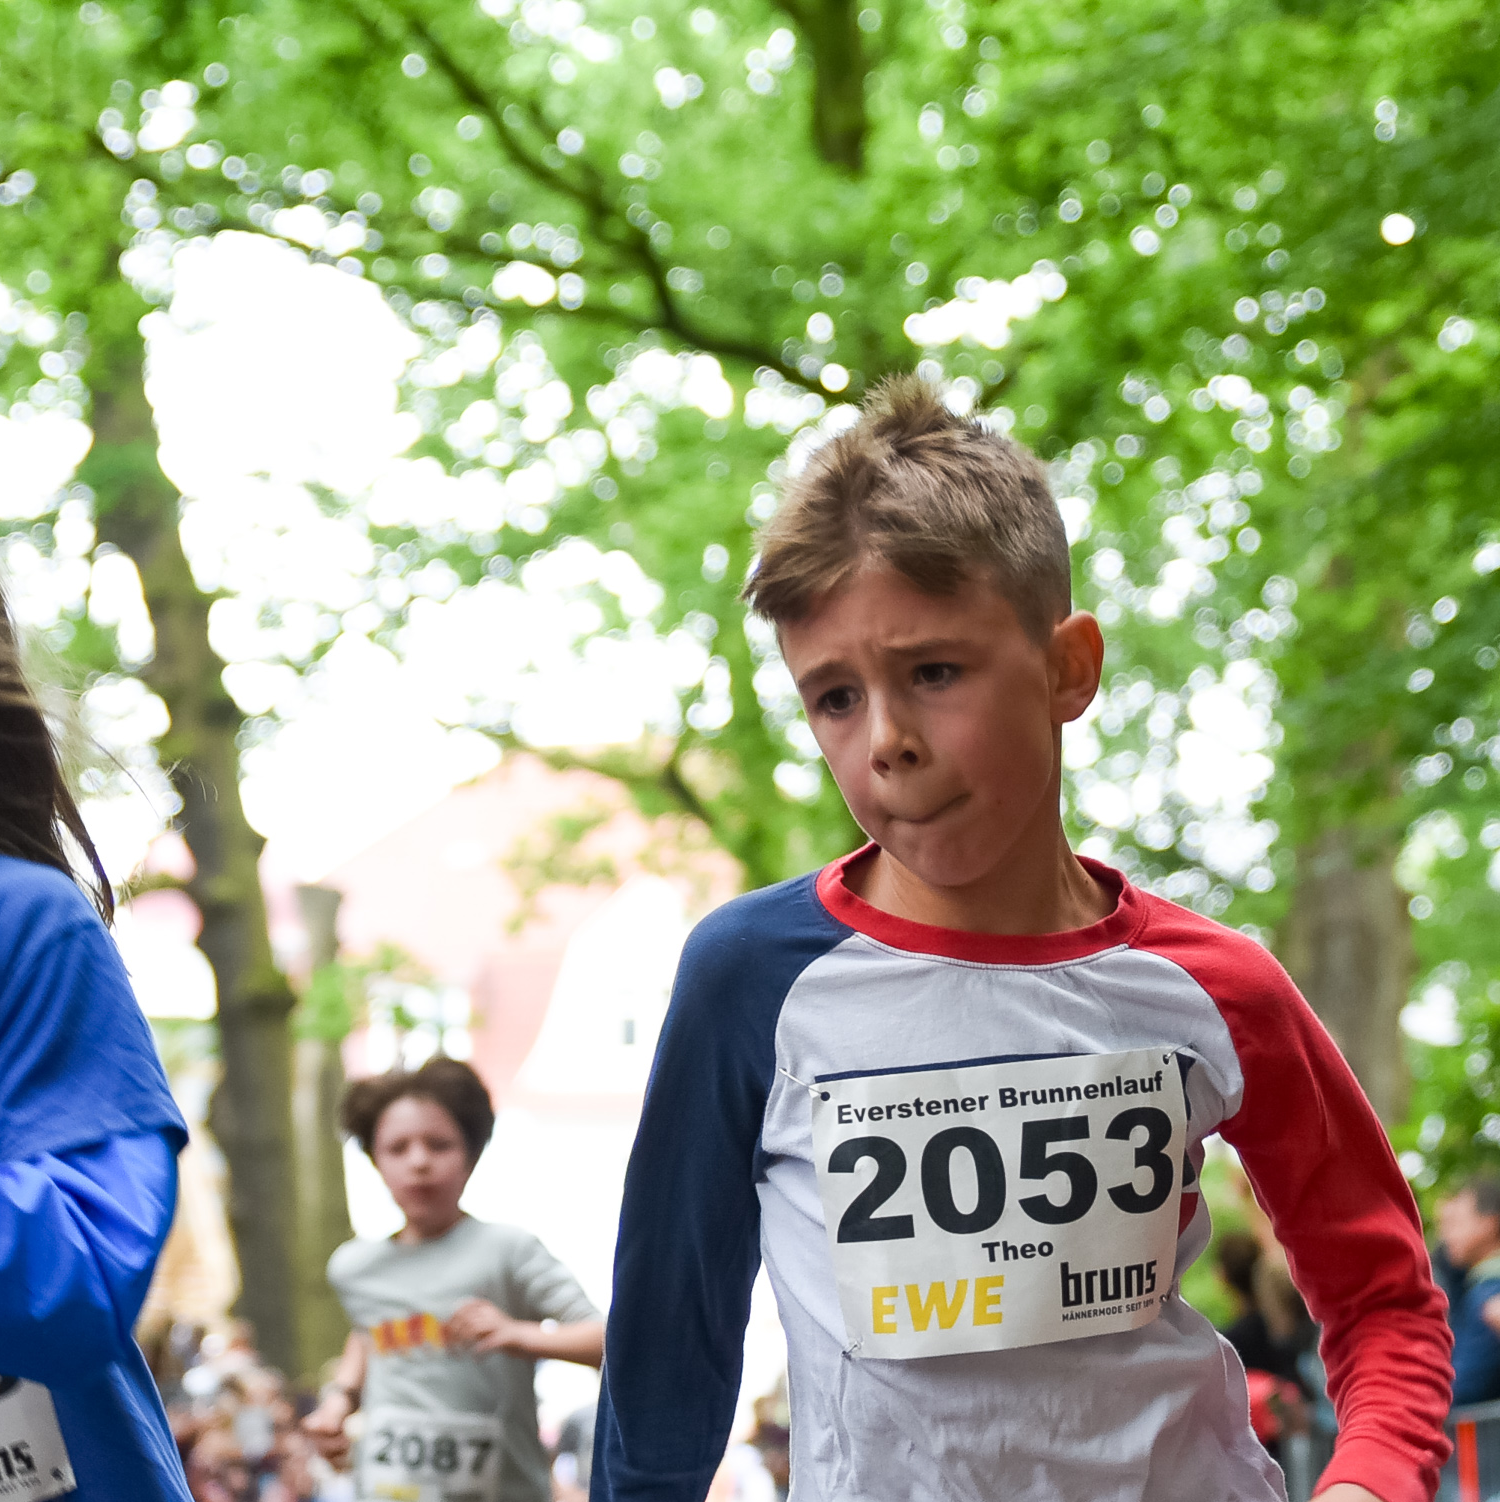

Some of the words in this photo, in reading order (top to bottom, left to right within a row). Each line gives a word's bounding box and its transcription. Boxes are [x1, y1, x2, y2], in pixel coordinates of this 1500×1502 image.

[837, 1095, 989, 1124] Everstener
[999, 1071, 1163, 1108] Brunnenlauf
[827, 1106, 1174, 1243] 2053
[982, 1240, 1054, 1263] Theo
[871, 1275, 1005, 1334] EWE
[1060, 1260, 1157, 1307] bruns
[1125, 1301, 1141, 1313] SEIT
[373, 1427, 493, 1475] 2087
